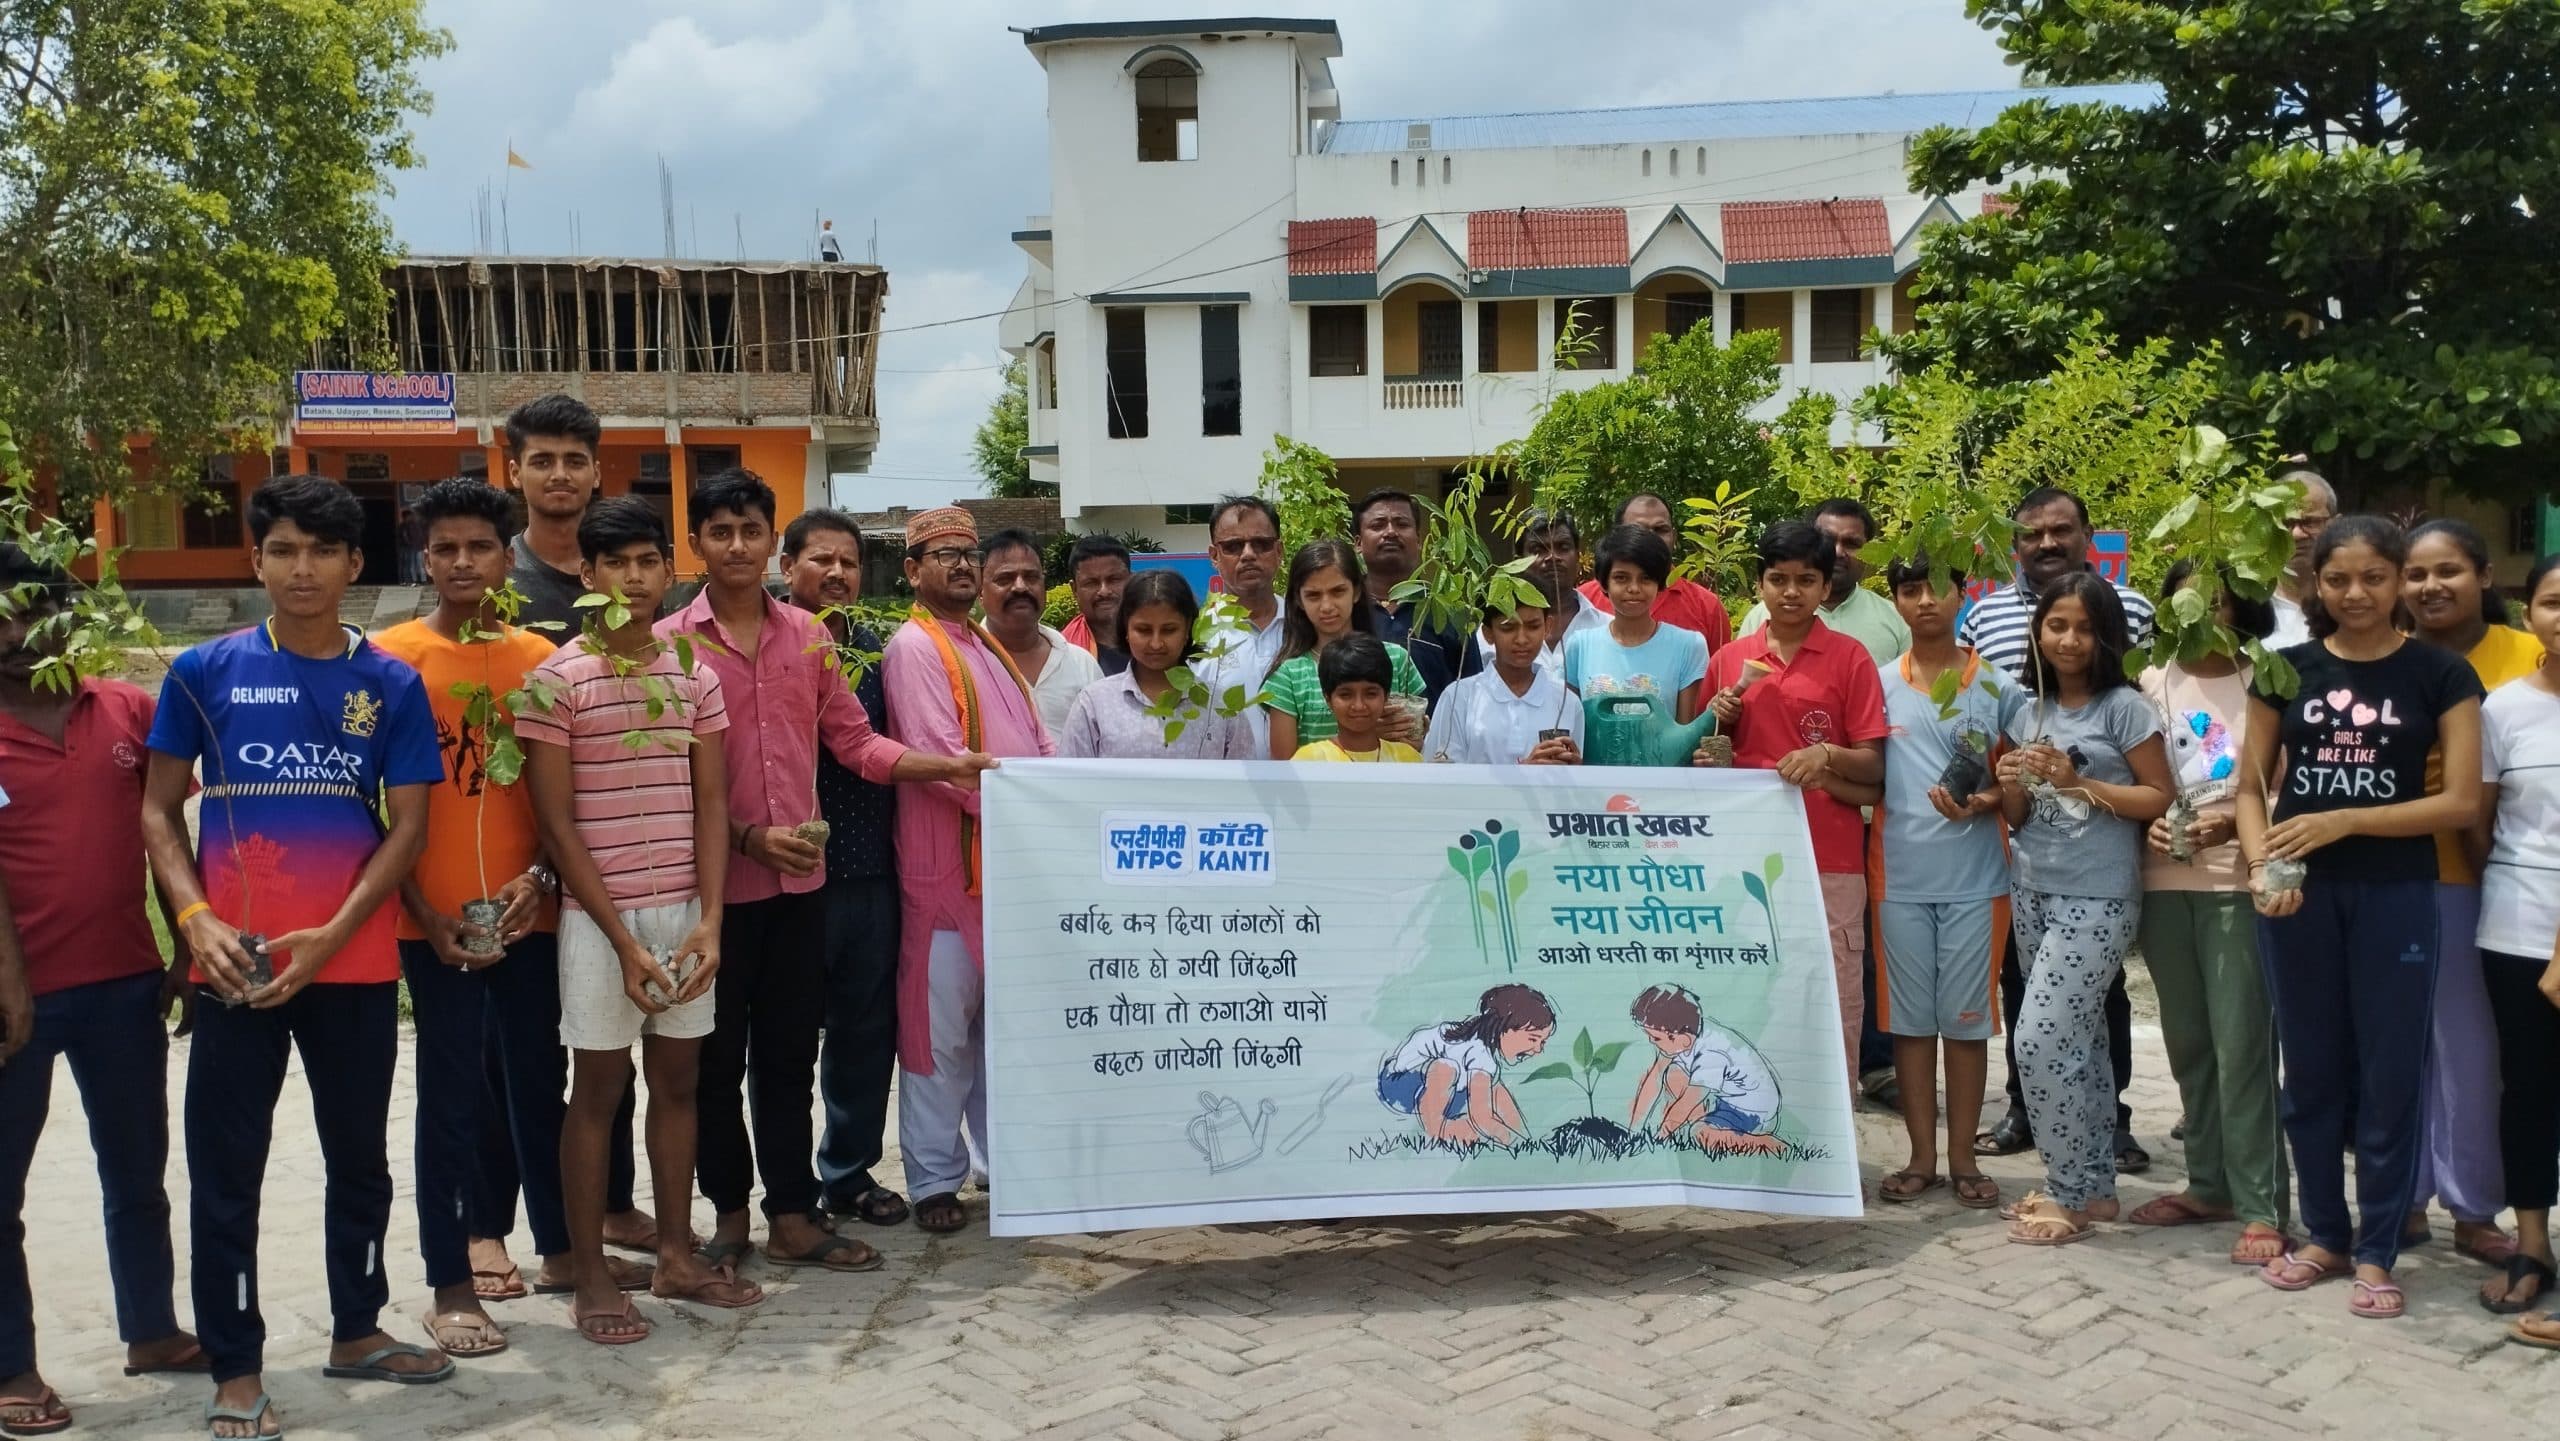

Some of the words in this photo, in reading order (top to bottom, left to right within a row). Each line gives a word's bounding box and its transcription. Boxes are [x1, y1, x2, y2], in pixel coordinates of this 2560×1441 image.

[302, 373, 369, 401] (SAINIK
[372, 373, 450, 402] SCHOOL)
[2334, 731, 2362, 745] GIRLS
[238, 742, 363, 776] QATAR
[2317, 748, 2341, 762] ARE
[2345, 749, 2376, 763] LIKE
[276, 764, 358, 783] AIRWA
[2294, 766, 2396, 798] STARS
[1111, 825, 1186, 849] एनटीपीसी
[1546, 813, 1630, 838] प्रभात
[1633, 814, 1714, 837] खबर
[1117, 850, 1182, 869] NTPC
[1199, 851, 1269, 871] KANTI
[1553, 864, 1620, 892] नया
[1627, 854, 1705, 892] पौधा
[1058, 904, 1113, 936] बर्बाद
[1122, 912, 1156, 935] कर
[1166, 906, 1211, 935] दिया
[1221, 904, 1286, 935] जंगलों
[1294, 904, 1321, 934] को
[1552, 905, 1619, 935] नया
[1626, 896, 1724, 935] जीवन
[1088, 957, 1140, 981] तबाह
[1149, 948, 1168, 980] हो
[1177, 949, 1220, 979] गयी
[1230, 948, 1298, 979] जिंदगी
[1537, 941, 1590, 965] आओ
[1598, 941, 1648, 964] धरती
[1653, 946, 1680, 965] का
[1740, 942, 1770, 965] करें
[1065, 1005, 1098, 1030] एक
[1108, 992, 1156, 1027] पौधा
[1165, 992, 1190, 1025] तो
[1199, 992, 1273, 1023] लगाओ
[1283, 991, 1328, 1023] यारों
[1093, 1049, 1144, 1076] बदल
[1154, 1037, 1223, 1070] जायेगी
[1232, 1036, 1303, 1068] जिंदगी
